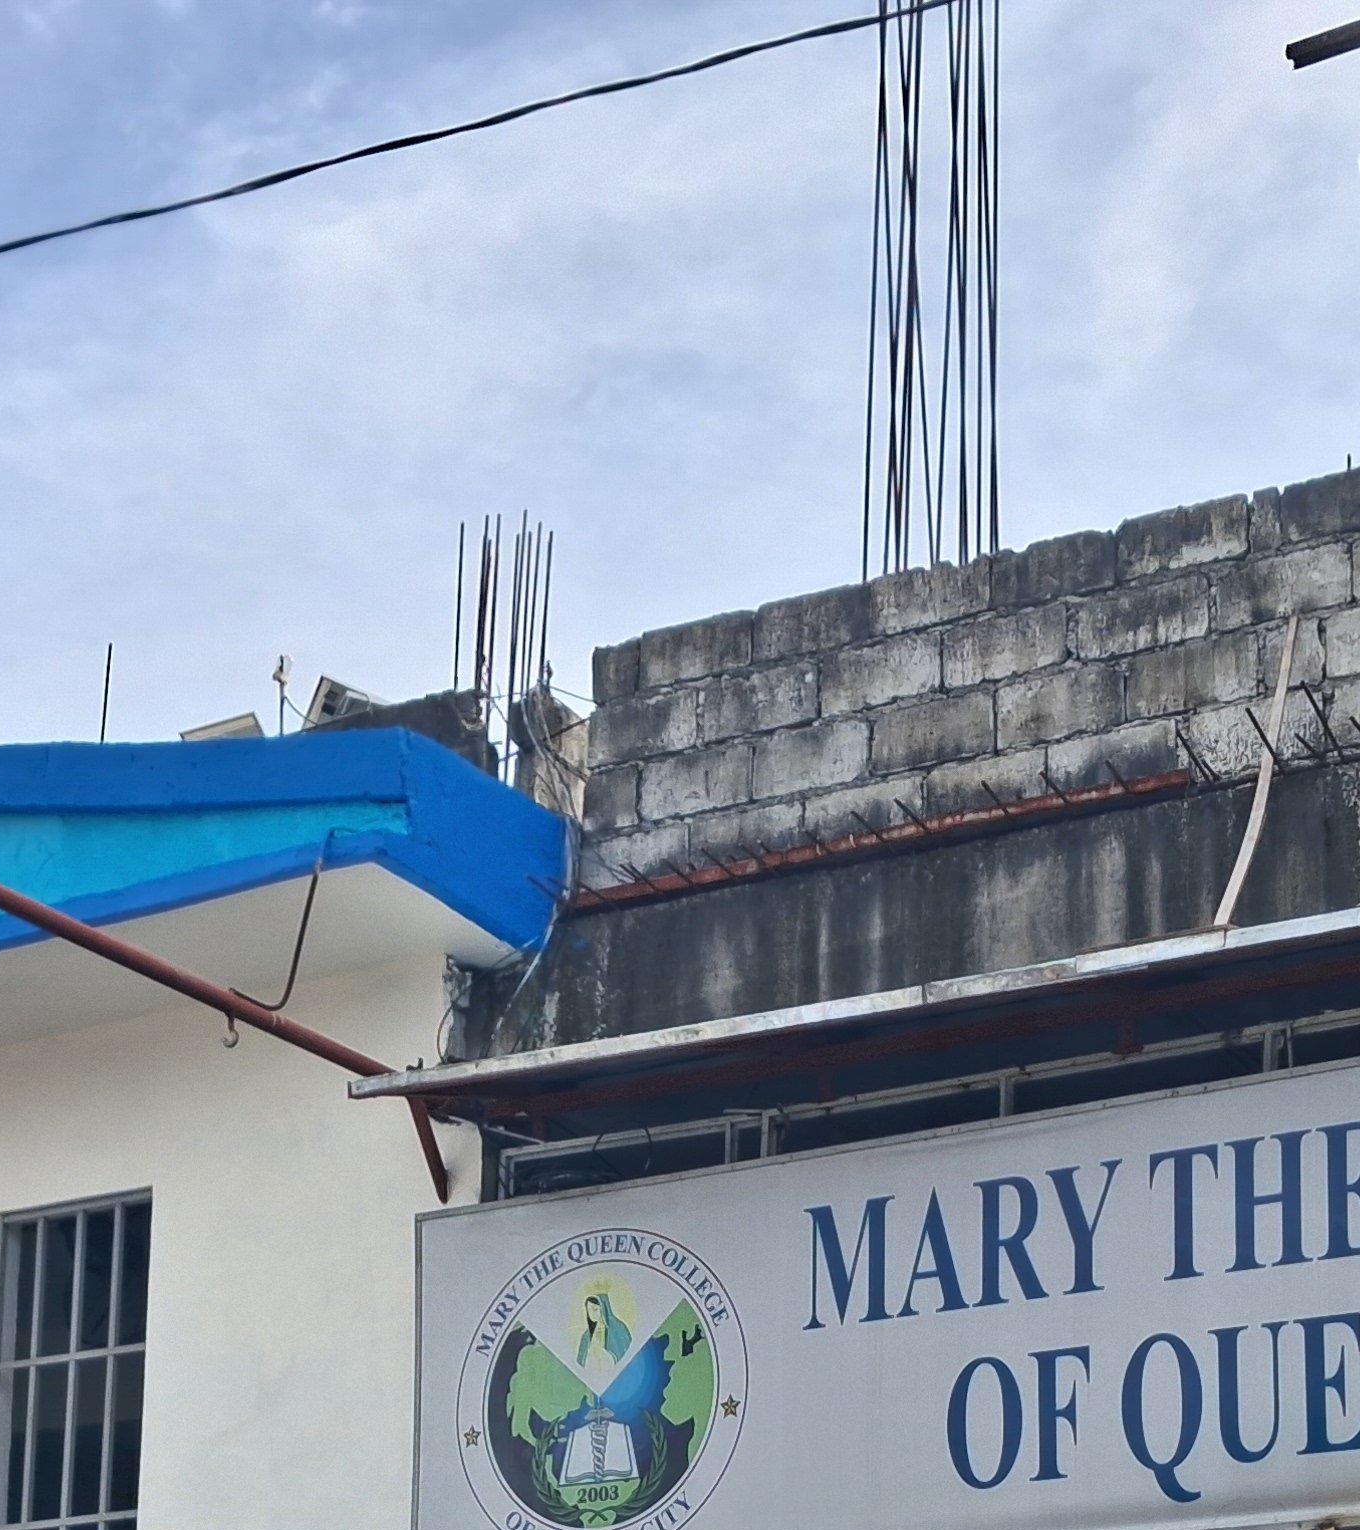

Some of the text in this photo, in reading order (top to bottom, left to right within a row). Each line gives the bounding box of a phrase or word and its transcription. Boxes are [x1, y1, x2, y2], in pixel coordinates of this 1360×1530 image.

[475, 1234, 730, 1357] MARY THE QUEEN COLLEGE
[802, 1158, 1123, 1330] MARY
[946, 1345, 1092, 1490] OF
[576, 1485, 619, 1504] 2003
